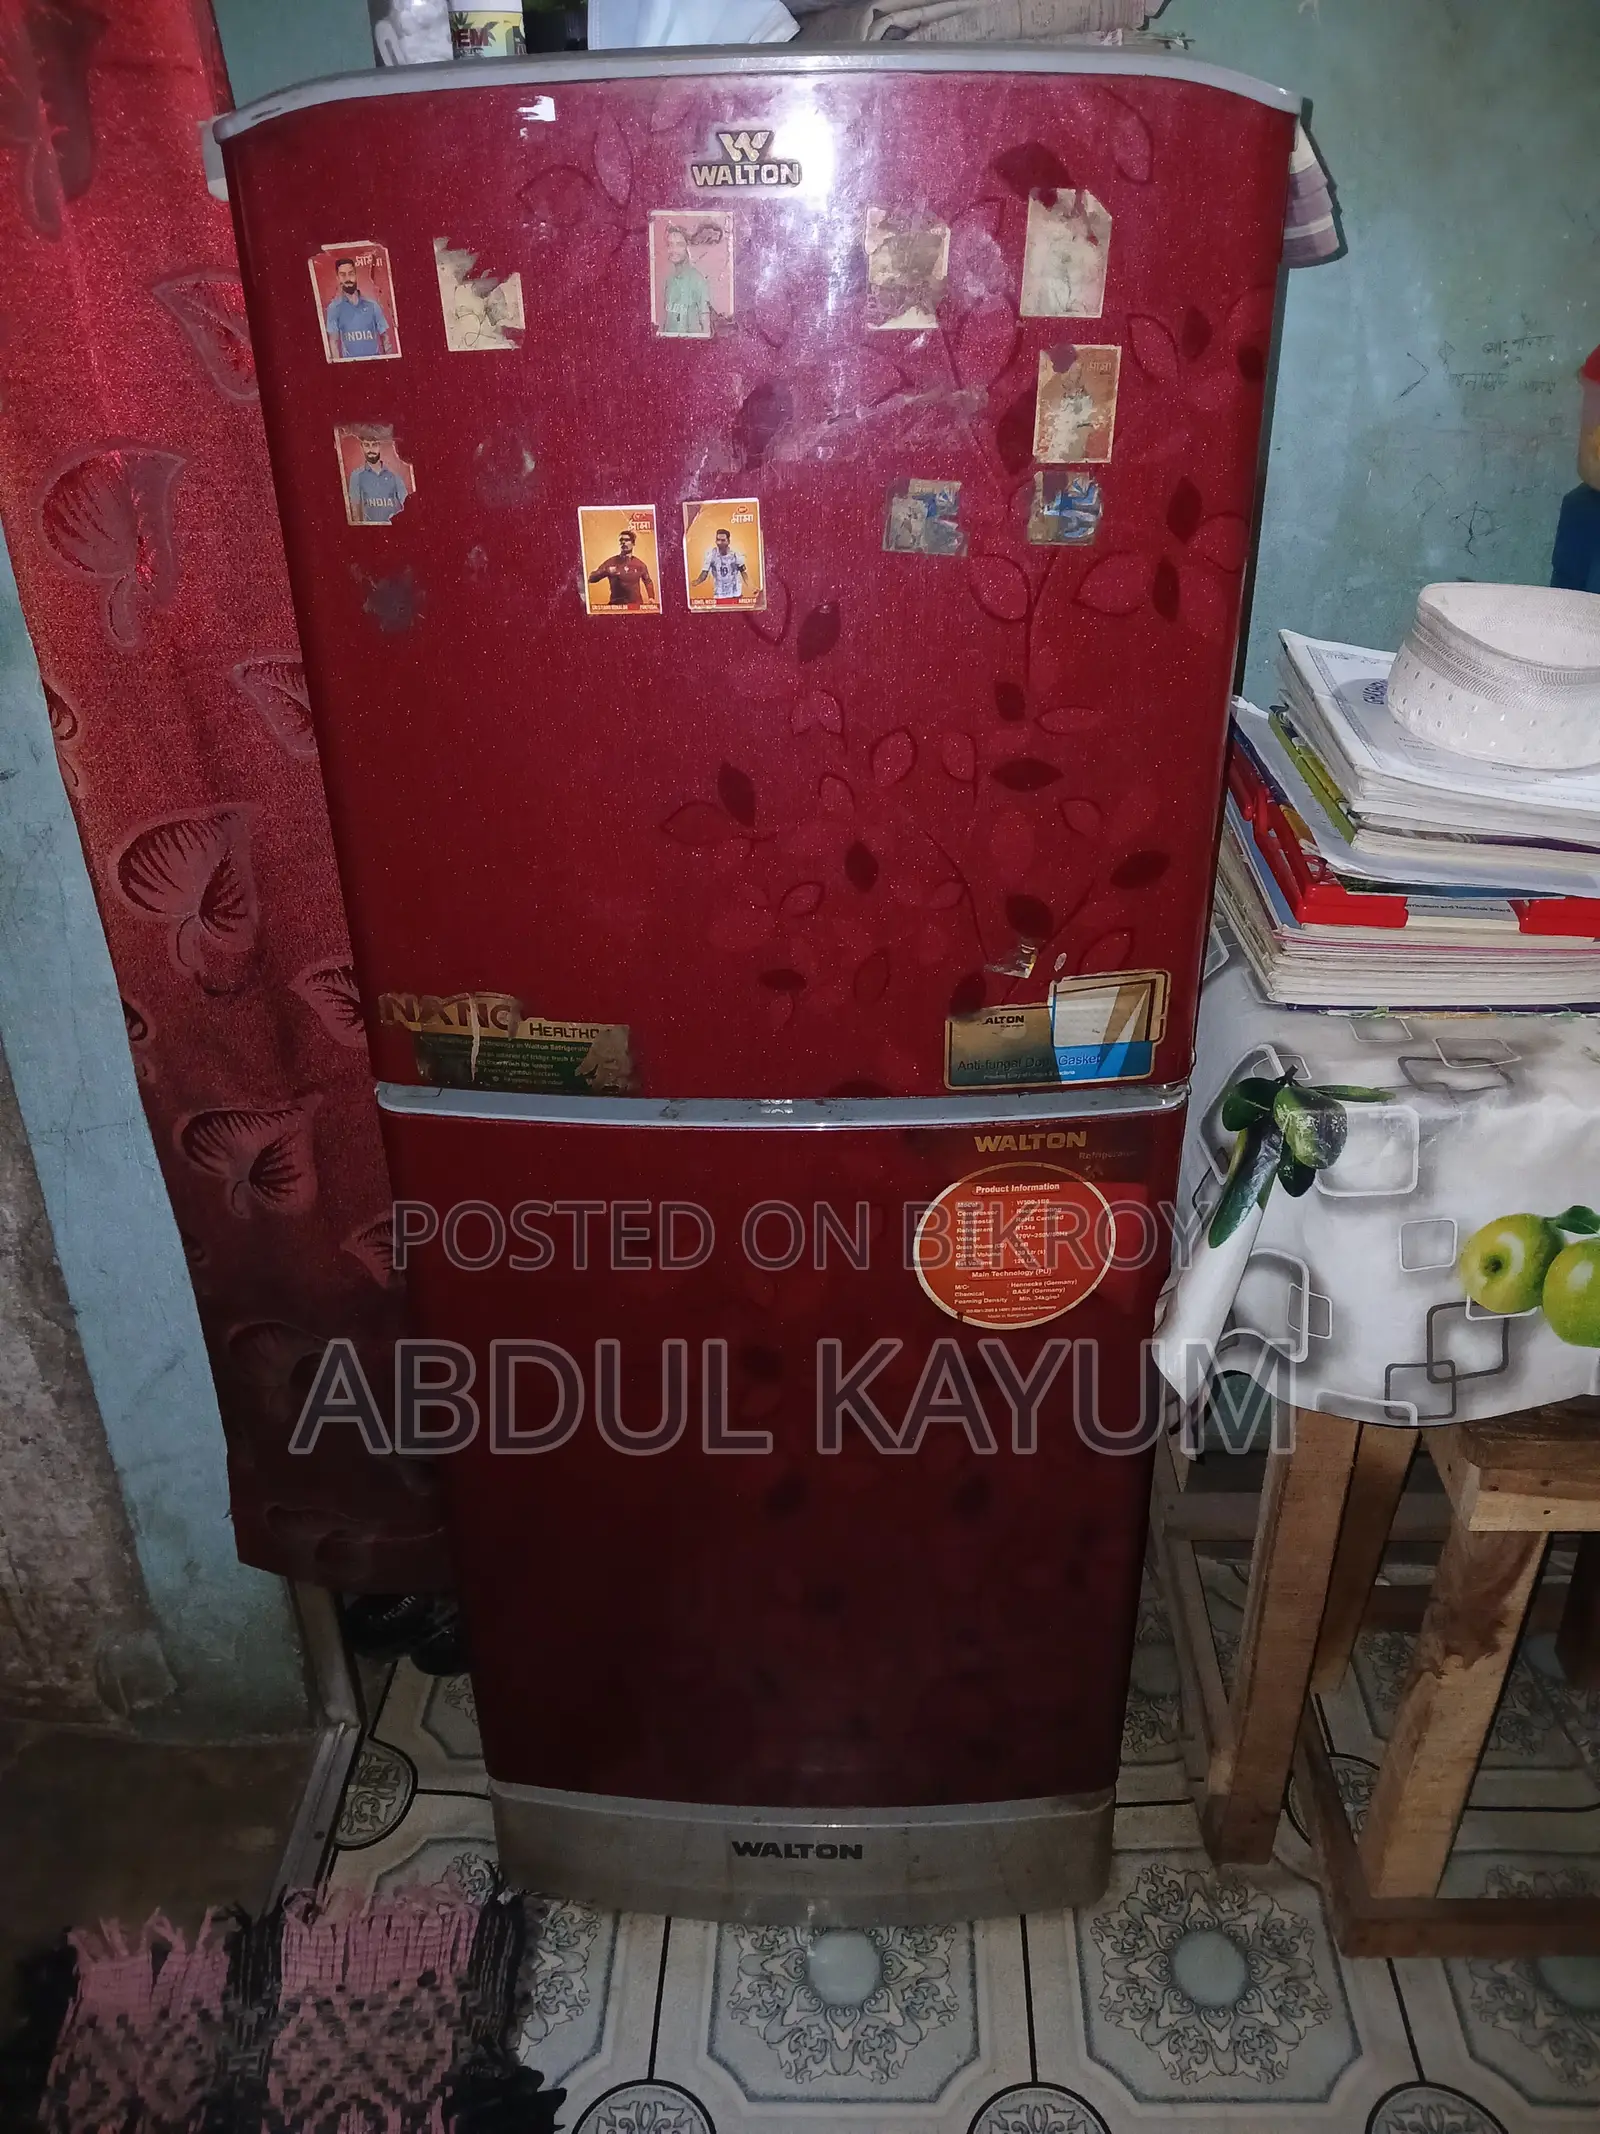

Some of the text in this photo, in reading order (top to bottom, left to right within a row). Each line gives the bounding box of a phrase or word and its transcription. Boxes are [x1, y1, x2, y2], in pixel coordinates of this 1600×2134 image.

[691, 163, 803, 187] WALTON
[957, 1057, 1021, 1072] Anti-fungal
[974, 1131, 1087, 1152] WALTON
[975, 1182, 1060, 1194] Product Information
[990, 1270, 1034, 1278] Technology
[1035, 1268, 1052, 1276] (PU)
[1044, 1278, 1078, 1287] (Germany)
[1032, 1286, 1066, 1294] (Germany)
[731, 1840, 863, 1860] WALTON
